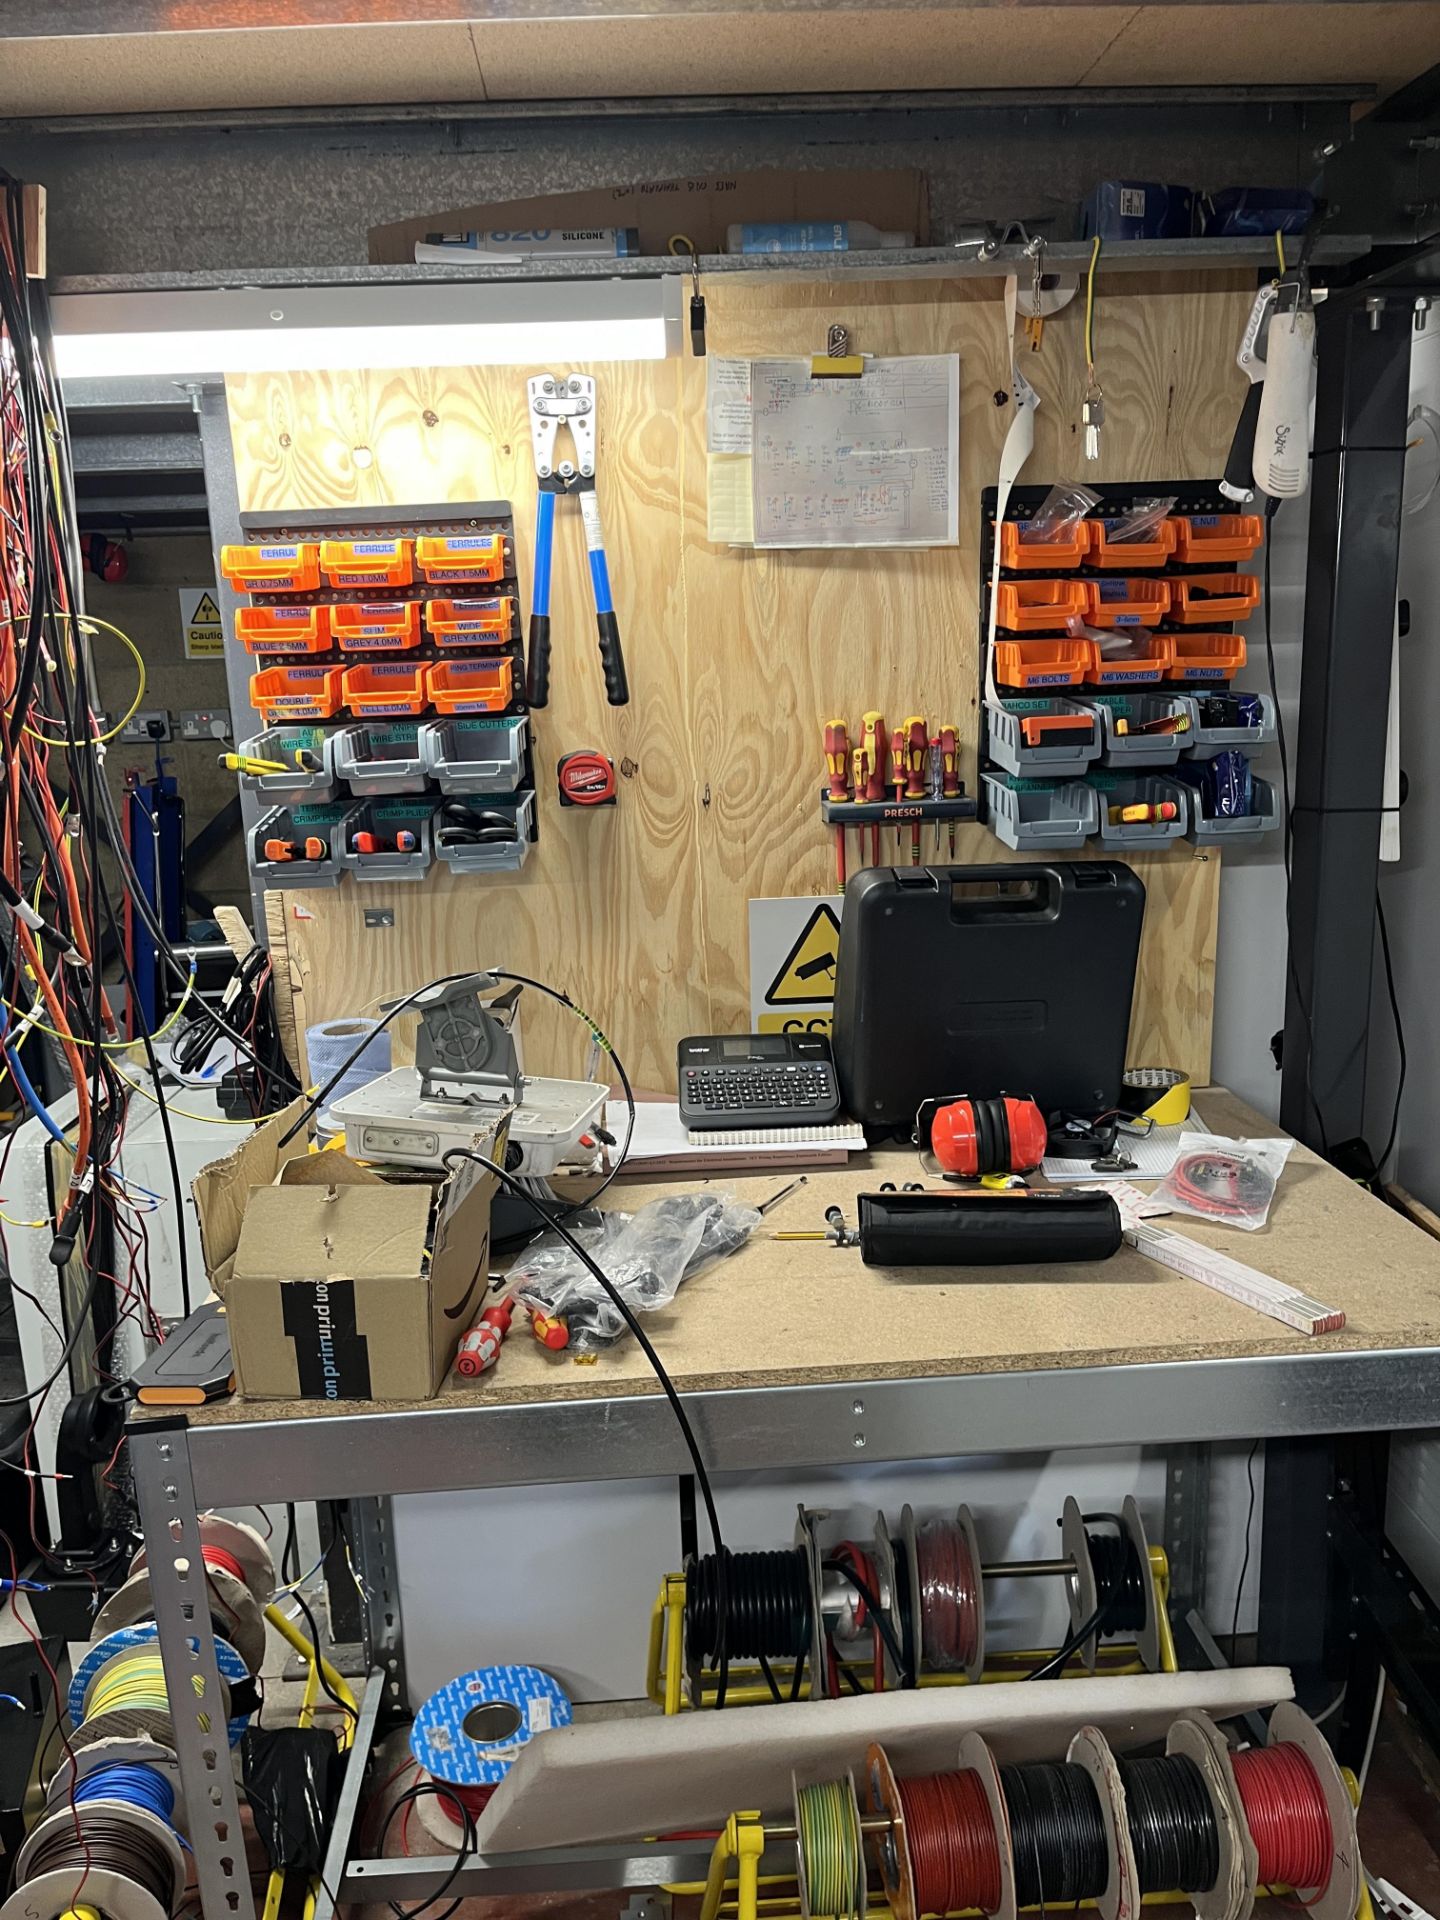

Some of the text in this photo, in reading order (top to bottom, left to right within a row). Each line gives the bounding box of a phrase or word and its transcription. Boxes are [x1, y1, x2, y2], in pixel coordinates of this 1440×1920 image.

[562, 232, 605, 241] SILICONE
[339, 574, 359, 583] RED
[429, 569, 461, 579] BLACK
[443, 634, 469, 643] GREY
[252, 642, 277, 651] BLUE
[345, 640, 371, 648] GREY
[1101, 671, 1160, 682] M6 WASHERS
[1185, 668, 1224, 678] M6 NUTS
[1026, 673, 1071, 686] M6 BOLTS
[1032, 700, 1049, 710] SET
[457, 719, 518, 731] SIDE CUTTERS
[281, 739, 303, 749] WIRE
[371, 734, 395, 744] WIRE
[884, 807, 923, 818] PRESCH
